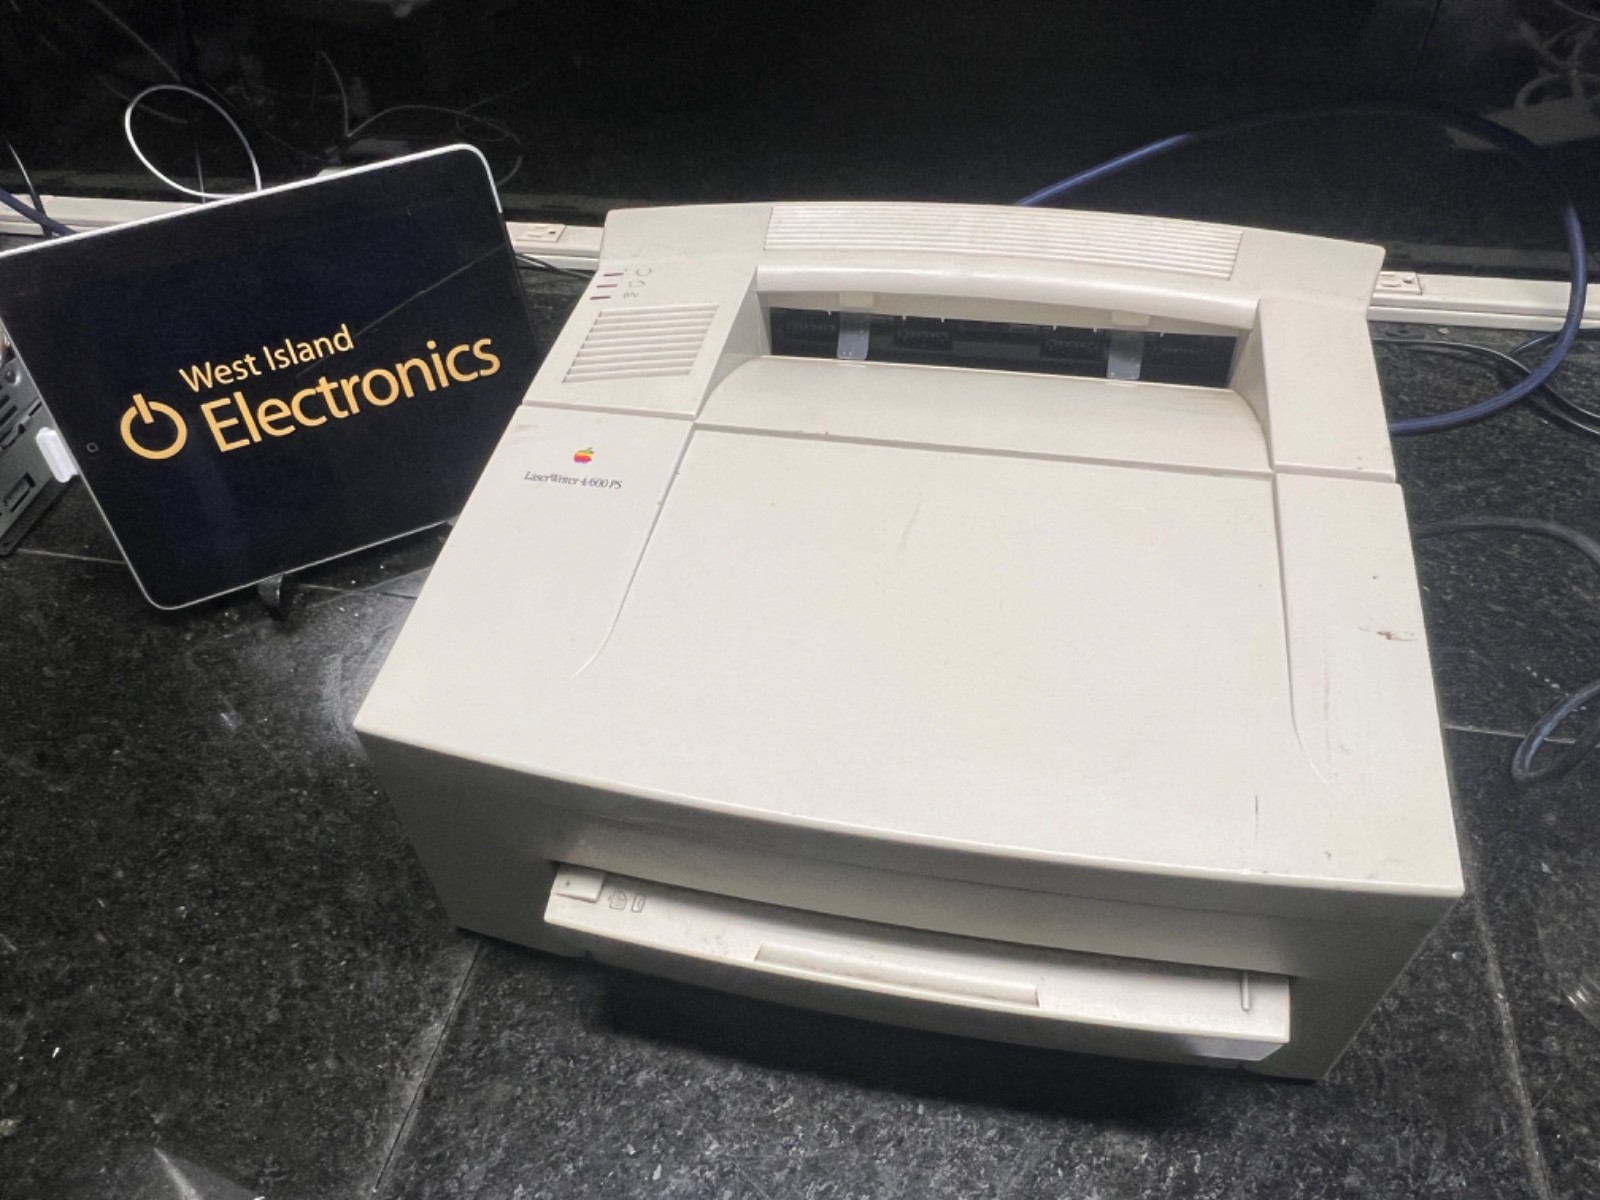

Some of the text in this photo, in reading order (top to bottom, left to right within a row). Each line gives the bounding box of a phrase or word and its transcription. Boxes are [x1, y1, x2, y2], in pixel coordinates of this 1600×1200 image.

[179, 323, 354, 392] West Island
[200, 337, 501, 453] Electronics
[523, 470, 580, 486] LaserWriter
[609, 478, 623, 490] PS
